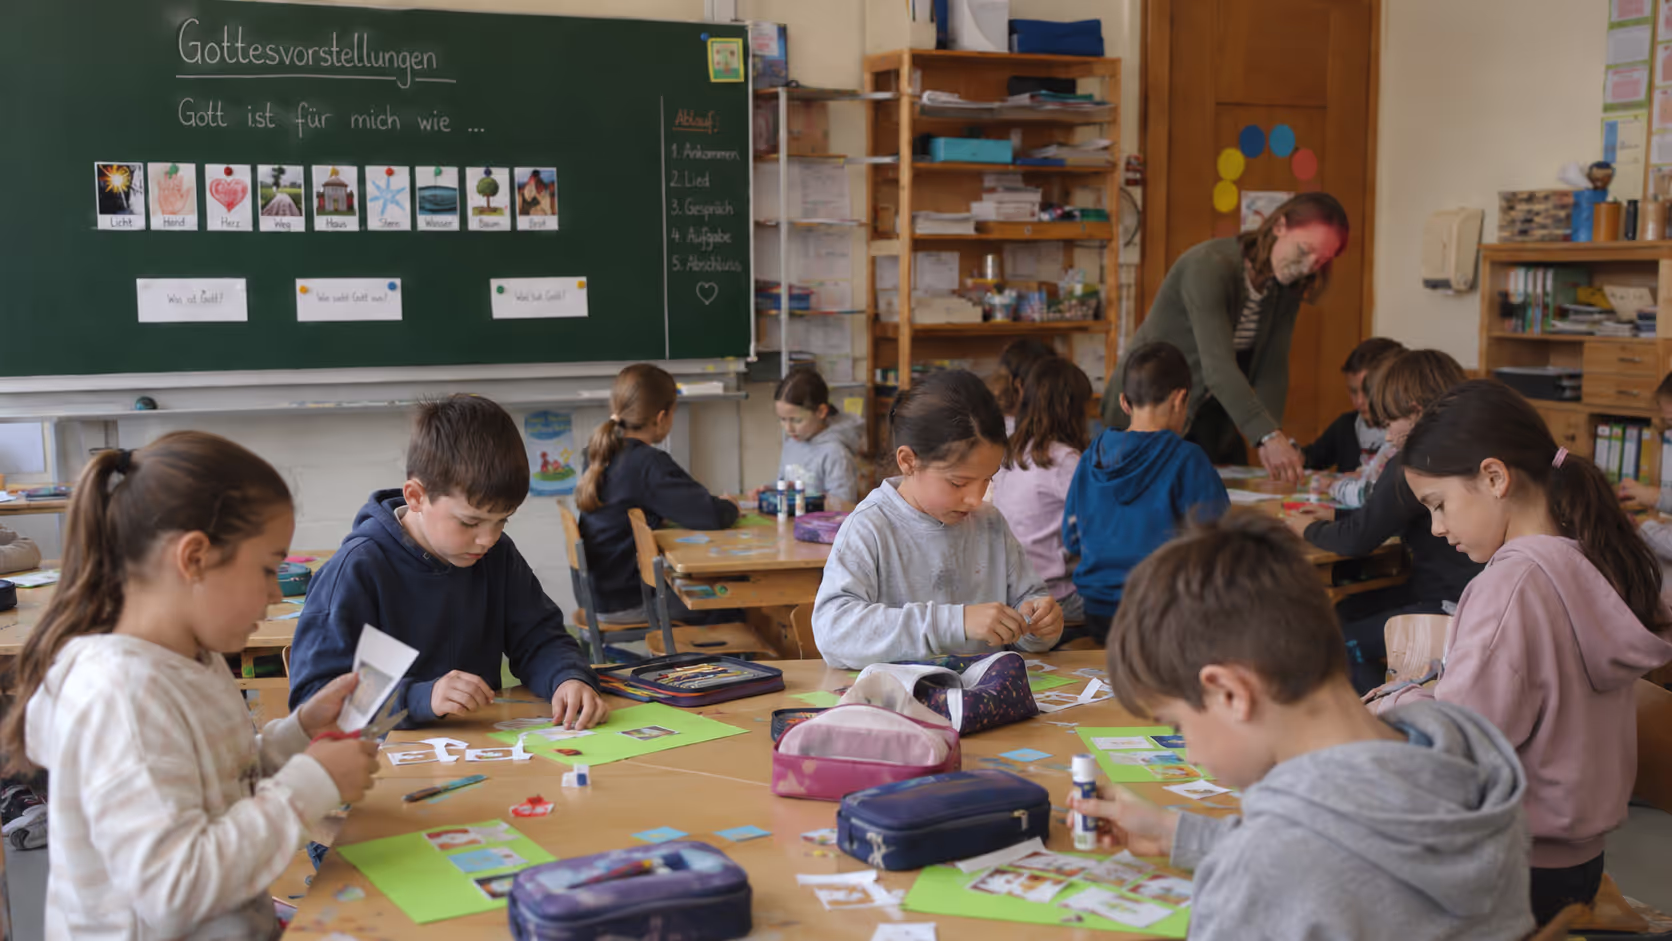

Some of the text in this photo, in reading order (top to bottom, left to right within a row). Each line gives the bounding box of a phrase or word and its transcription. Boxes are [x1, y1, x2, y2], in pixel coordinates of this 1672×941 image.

[178, 18, 438, 88] Gottesvorstellungen
[178, 97, 228, 128] Gott
[248, 102, 275, 128] ist
[295, 102, 333, 138] für
[351, 105, 400, 131] mich
[418, 110, 451, 132] wie
[683, 142, 741, 160] Ankommen
[670, 169, 710, 187] 2. Lied
[671, 197, 734, 222] 3. Gespräch
[110, 216, 133, 228] Licht
[163, 216, 185, 227] Hand
[220, 216, 241, 228] Herz
[273, 218, 291, 230] Weg
[326, 218, 347, 228] Haus
[686, 225, 732, 251] Aufgabe
[672, 254, 684, 272] 5.
